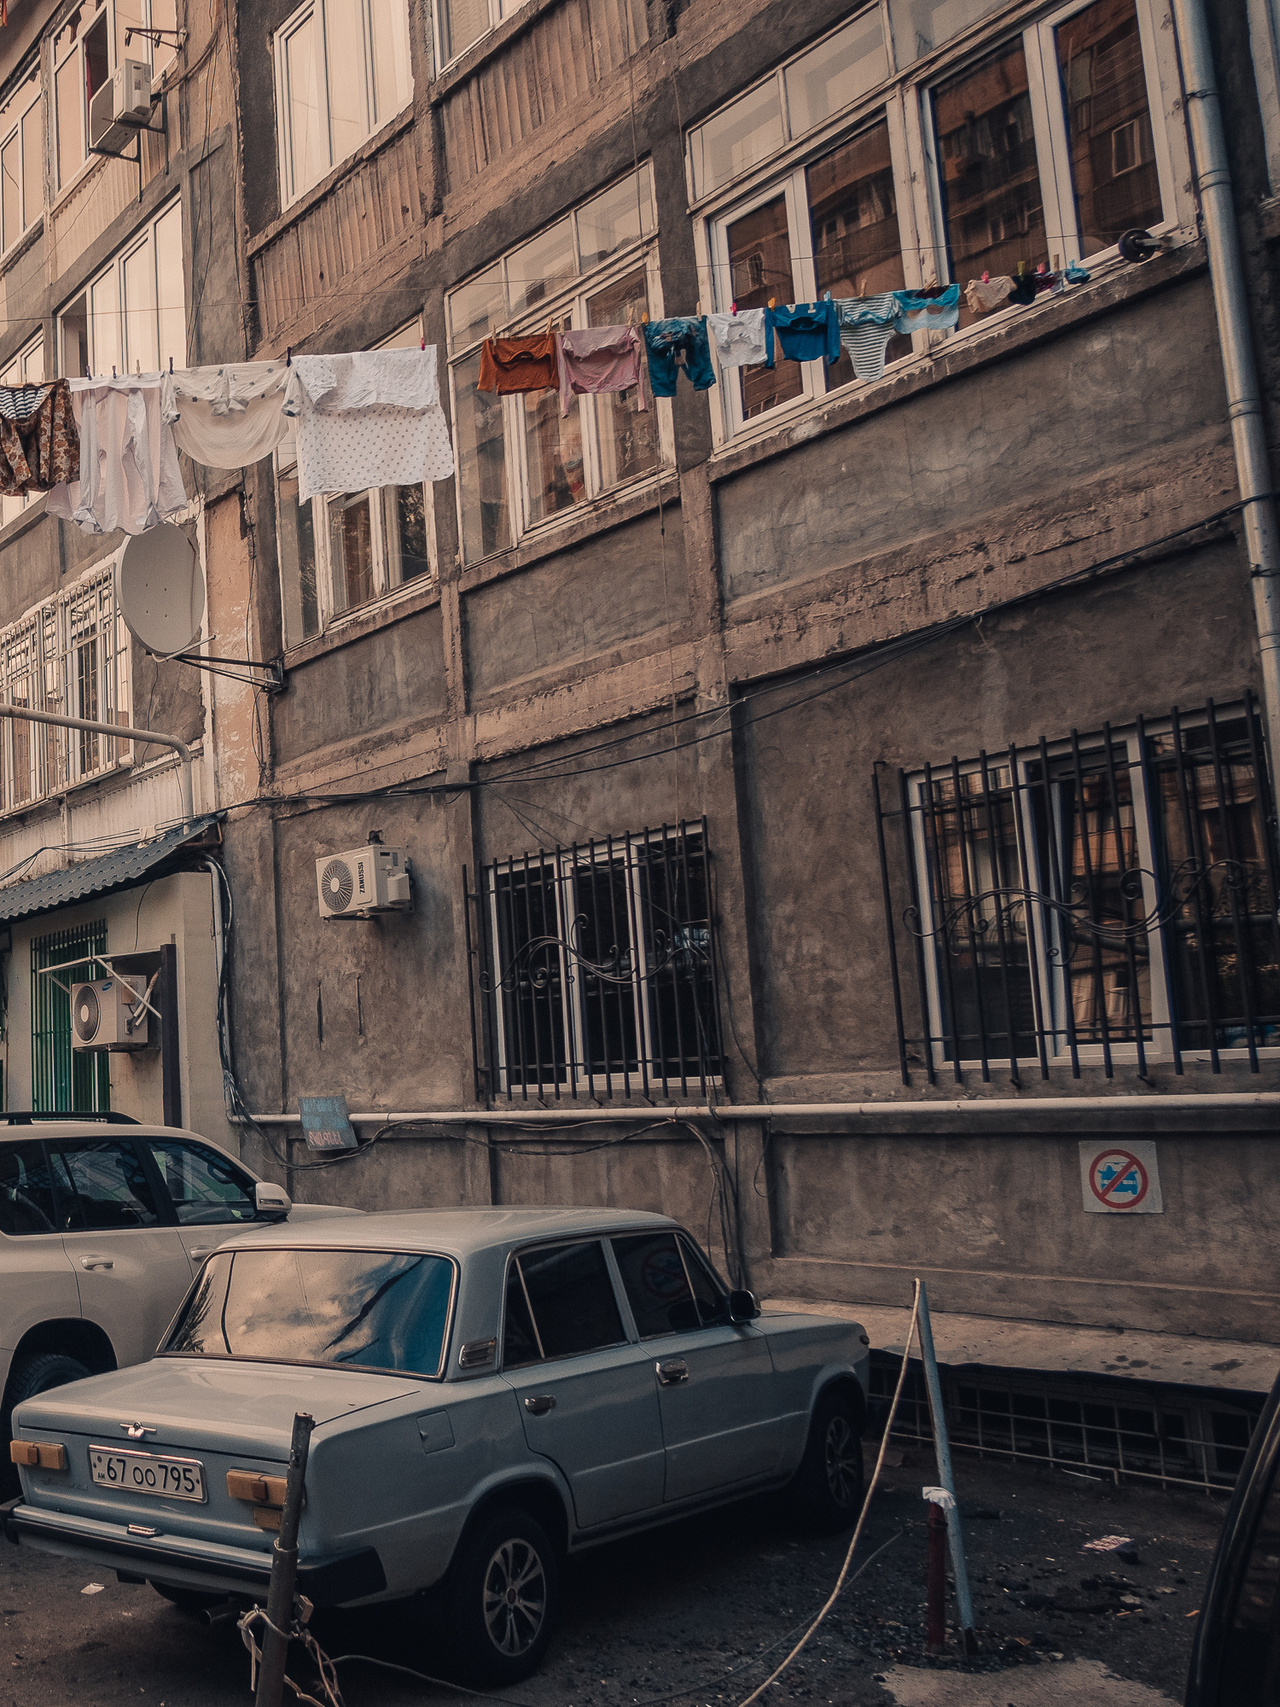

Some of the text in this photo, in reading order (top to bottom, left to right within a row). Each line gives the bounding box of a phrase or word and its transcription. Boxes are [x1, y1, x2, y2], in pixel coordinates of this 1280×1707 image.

[357, 862, 365, 894] ZANUSSI
[106, 1457, 127, 1483] 67
[157, 1464, 196, 1493] 795
